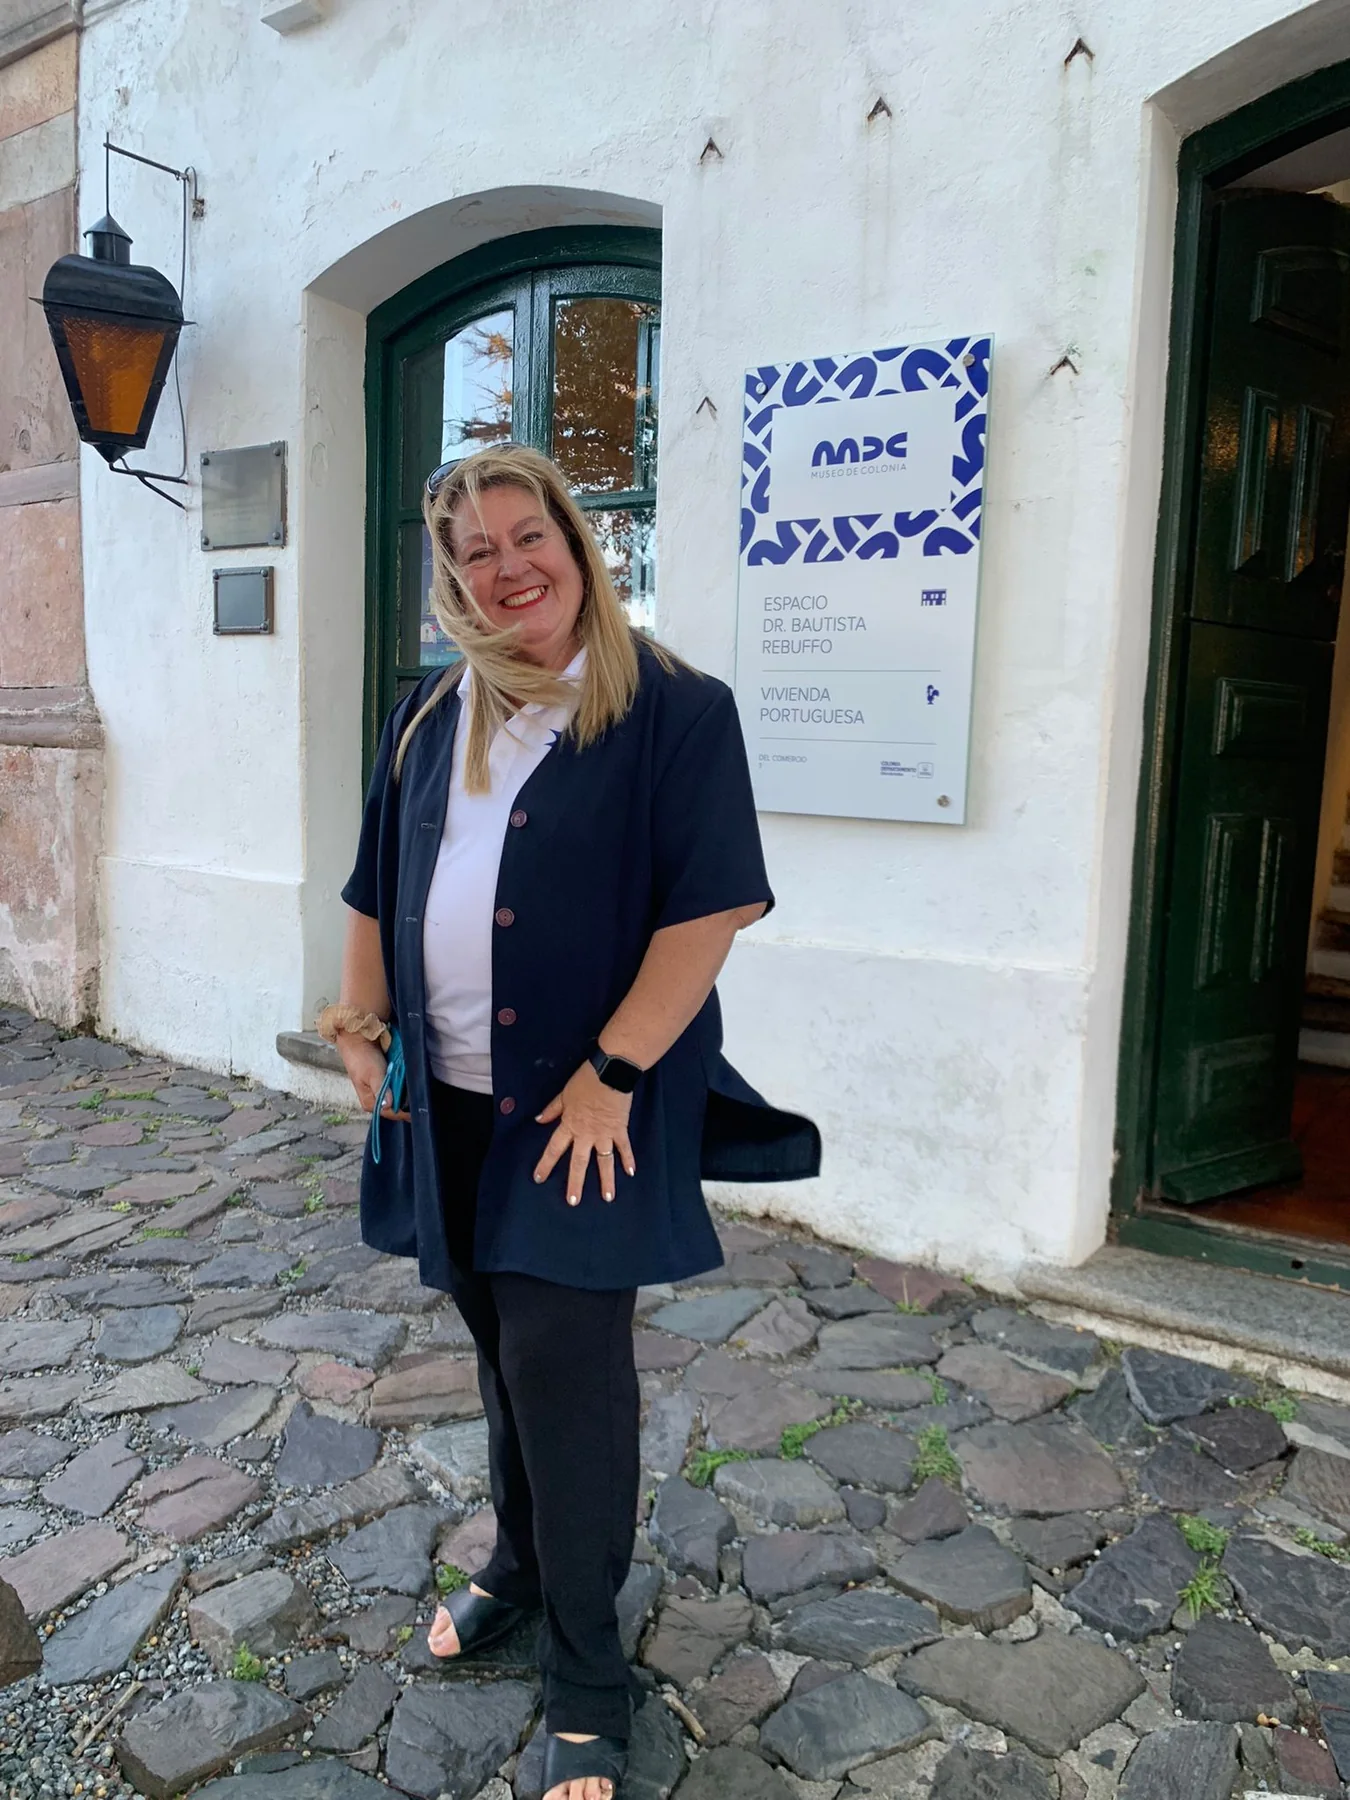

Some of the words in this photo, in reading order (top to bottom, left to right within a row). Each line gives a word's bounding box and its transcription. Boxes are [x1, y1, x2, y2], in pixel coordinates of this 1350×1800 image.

[811, 468, 844, 479] MUSEO
[846, 467, 858, 477] DE
[860, 463, 907, 476] COLONIA
[764, 595, 828, 612] ESPACIO
[763, 618, 786, 633] DR.
[792, 616, 867, 632] BAUTISTA
[763, 639, 832, 654] REBUFFO
[761, 687, 831, 702] VIVIENDA
[760, 708, 865, 724] PORTUGUESA
[758, 754, 770, 762] DEL
[772, 755, 808, 764] COMERCIO
